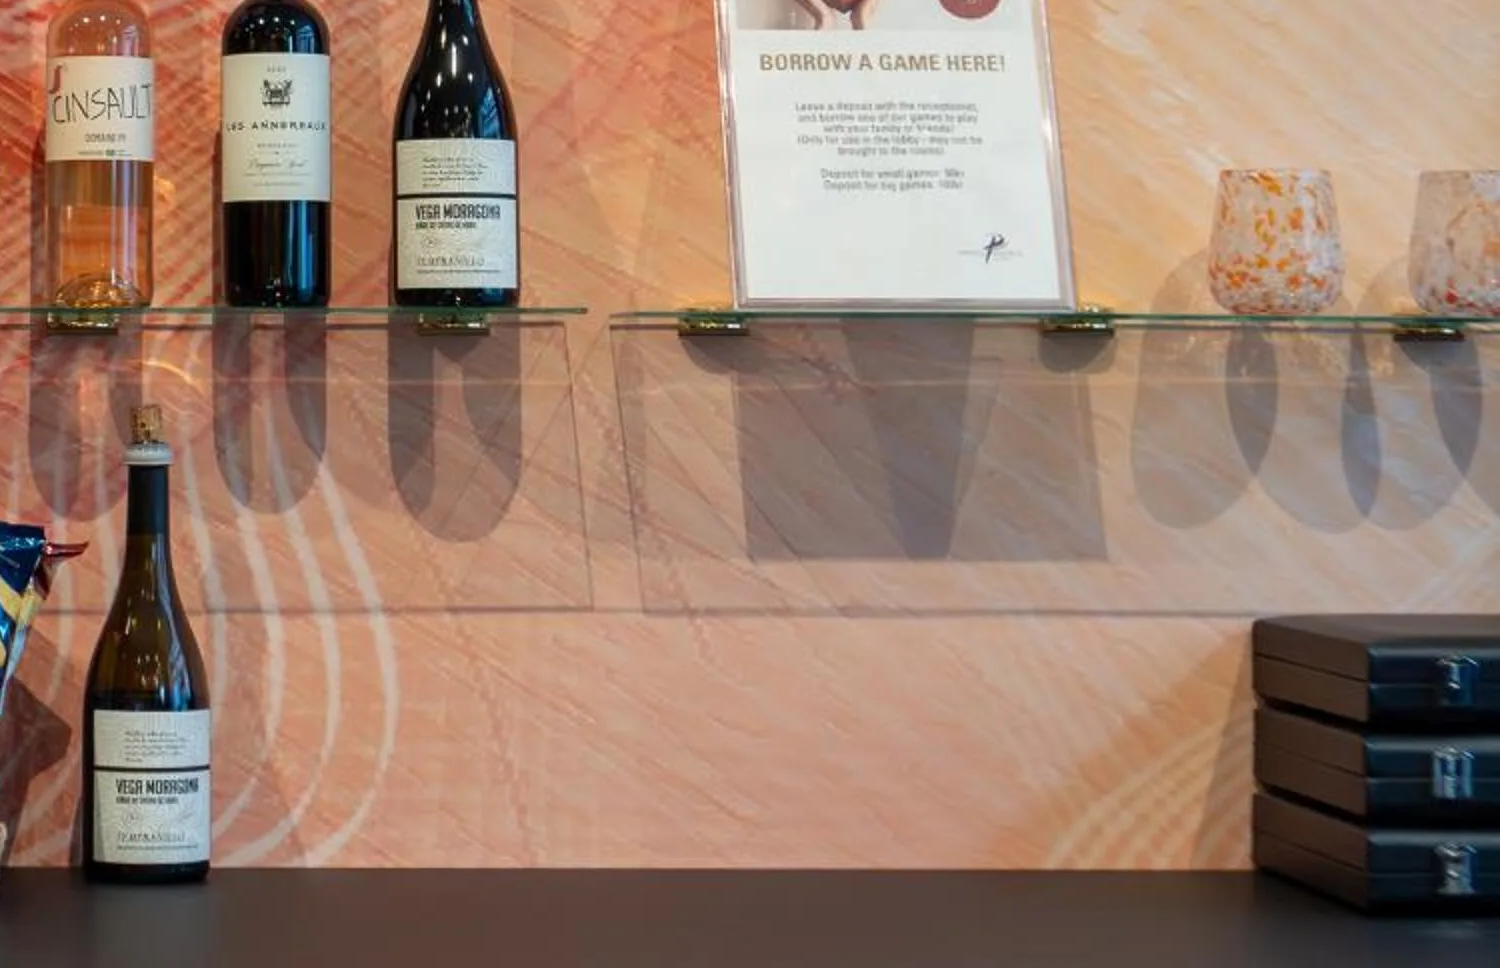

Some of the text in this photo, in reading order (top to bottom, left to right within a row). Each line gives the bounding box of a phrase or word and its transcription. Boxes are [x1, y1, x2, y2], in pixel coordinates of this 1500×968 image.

[760, 53, 1005, 73] BORROW A GAME HERE!
[52, 83, 152, 123] CINSAULT
[874, 102, 898, 111] with
[899, 102, 915, 111] the
[798, 114, 816, 122] and
[878, 114, 889, 122] of
[910, 116, 942, 124] games
[957, 114, 978, 124] play
[826, 135, 838, 144] for
[873, 135, 890, 144] the
[891, 146, 907, 155] the
[820, 169, 859, 180] Deposit
[861, 169, 874, 178] for
[823, 181, 862, 191] Deposit
[865, 181, 878, 189] for
[881, 181, 897, 191] big
[415, 204, 441, 220] VEGA
[115, 778, 143, 795] VEGA
